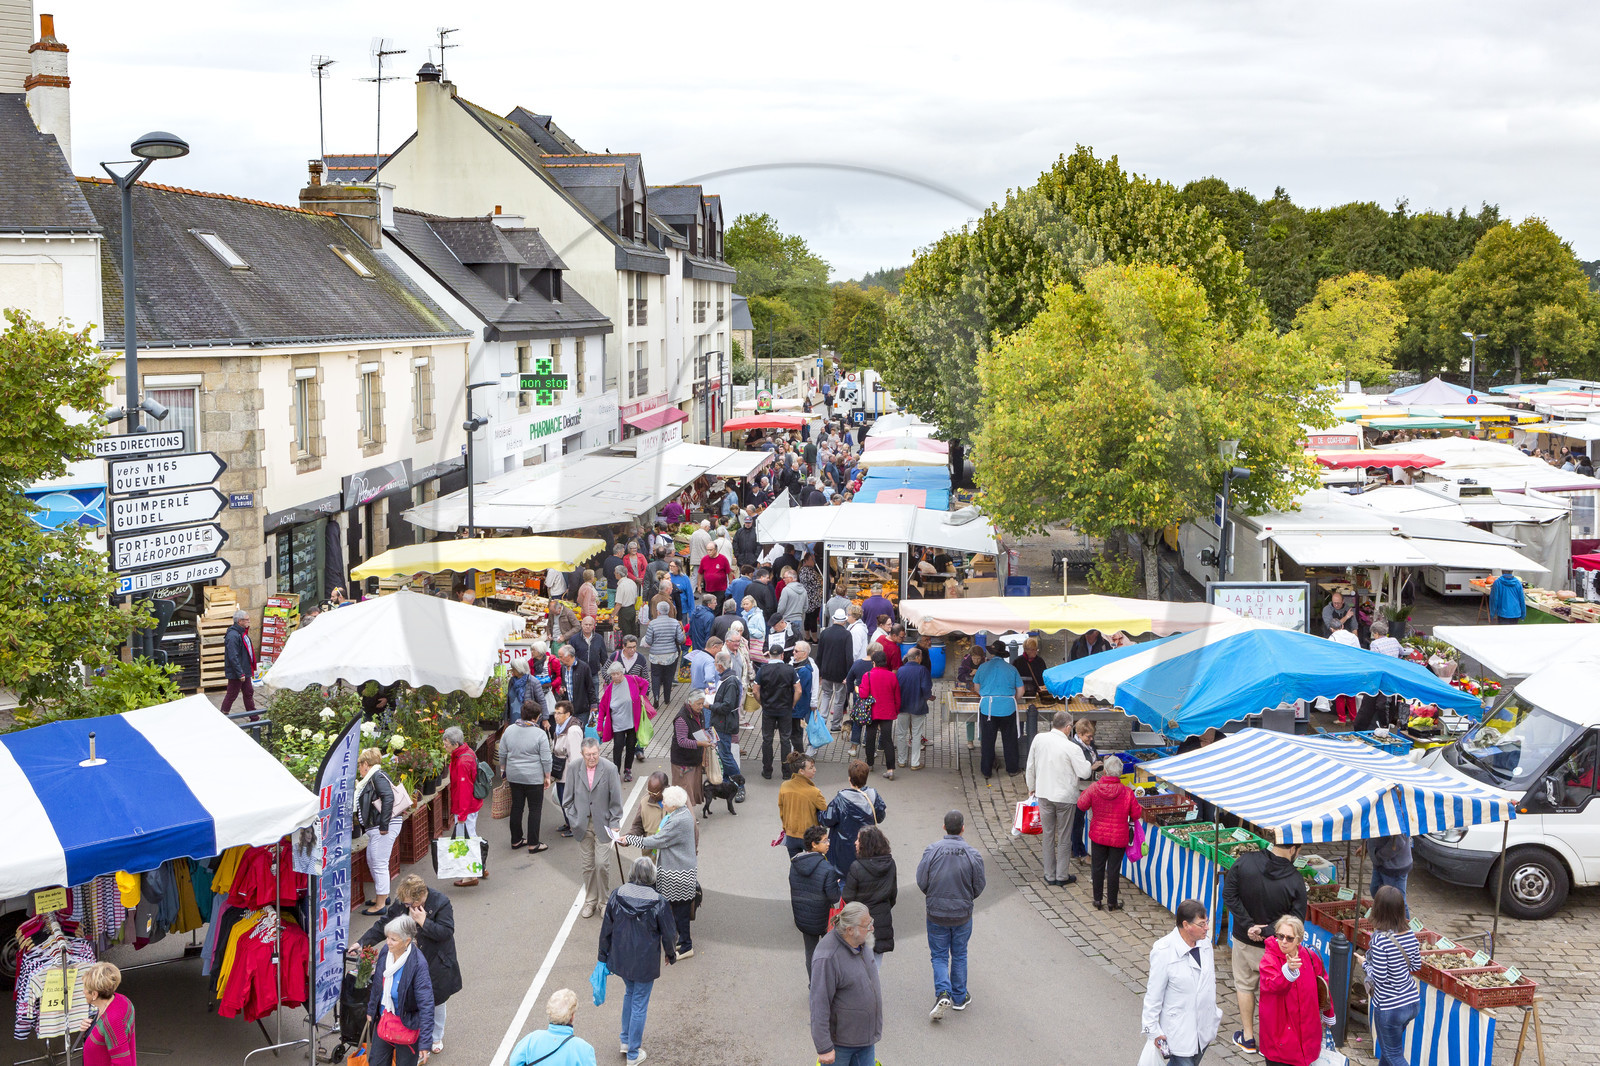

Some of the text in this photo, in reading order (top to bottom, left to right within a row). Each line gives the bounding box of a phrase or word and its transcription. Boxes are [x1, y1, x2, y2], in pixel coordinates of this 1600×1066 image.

[520, 378, 568, 390] non stop
[529, 415, 562, 440] PHARMACIE
[120, 436, 180, 450] DIRECTIONS
[117, 465, 140, 476] vers
[116, 474, 165, 489] QUEVEN
[117, 494, 189, 515] QUIMPERLÉ
[117, 512, 164, 527] GUIDEL
[279, 512, 296, 525] ACHAT
[118, 529, 200, 553] FORT-BLOQUÉ
[847, 540, 869, 551] 80 90
[135, 544, 193, 563] AÉROPORT
[165, 571, 179, 582] 85
[186, 565, 219, 580] places
[1225, 594, 1294, 603] JARDINS
[334, 732, 356, 860] VETEMENTS
[331, 867, 347, 956] MARINS
[1311, 932, 1322, 951] la
[47, 999, 59, 1008] 15
